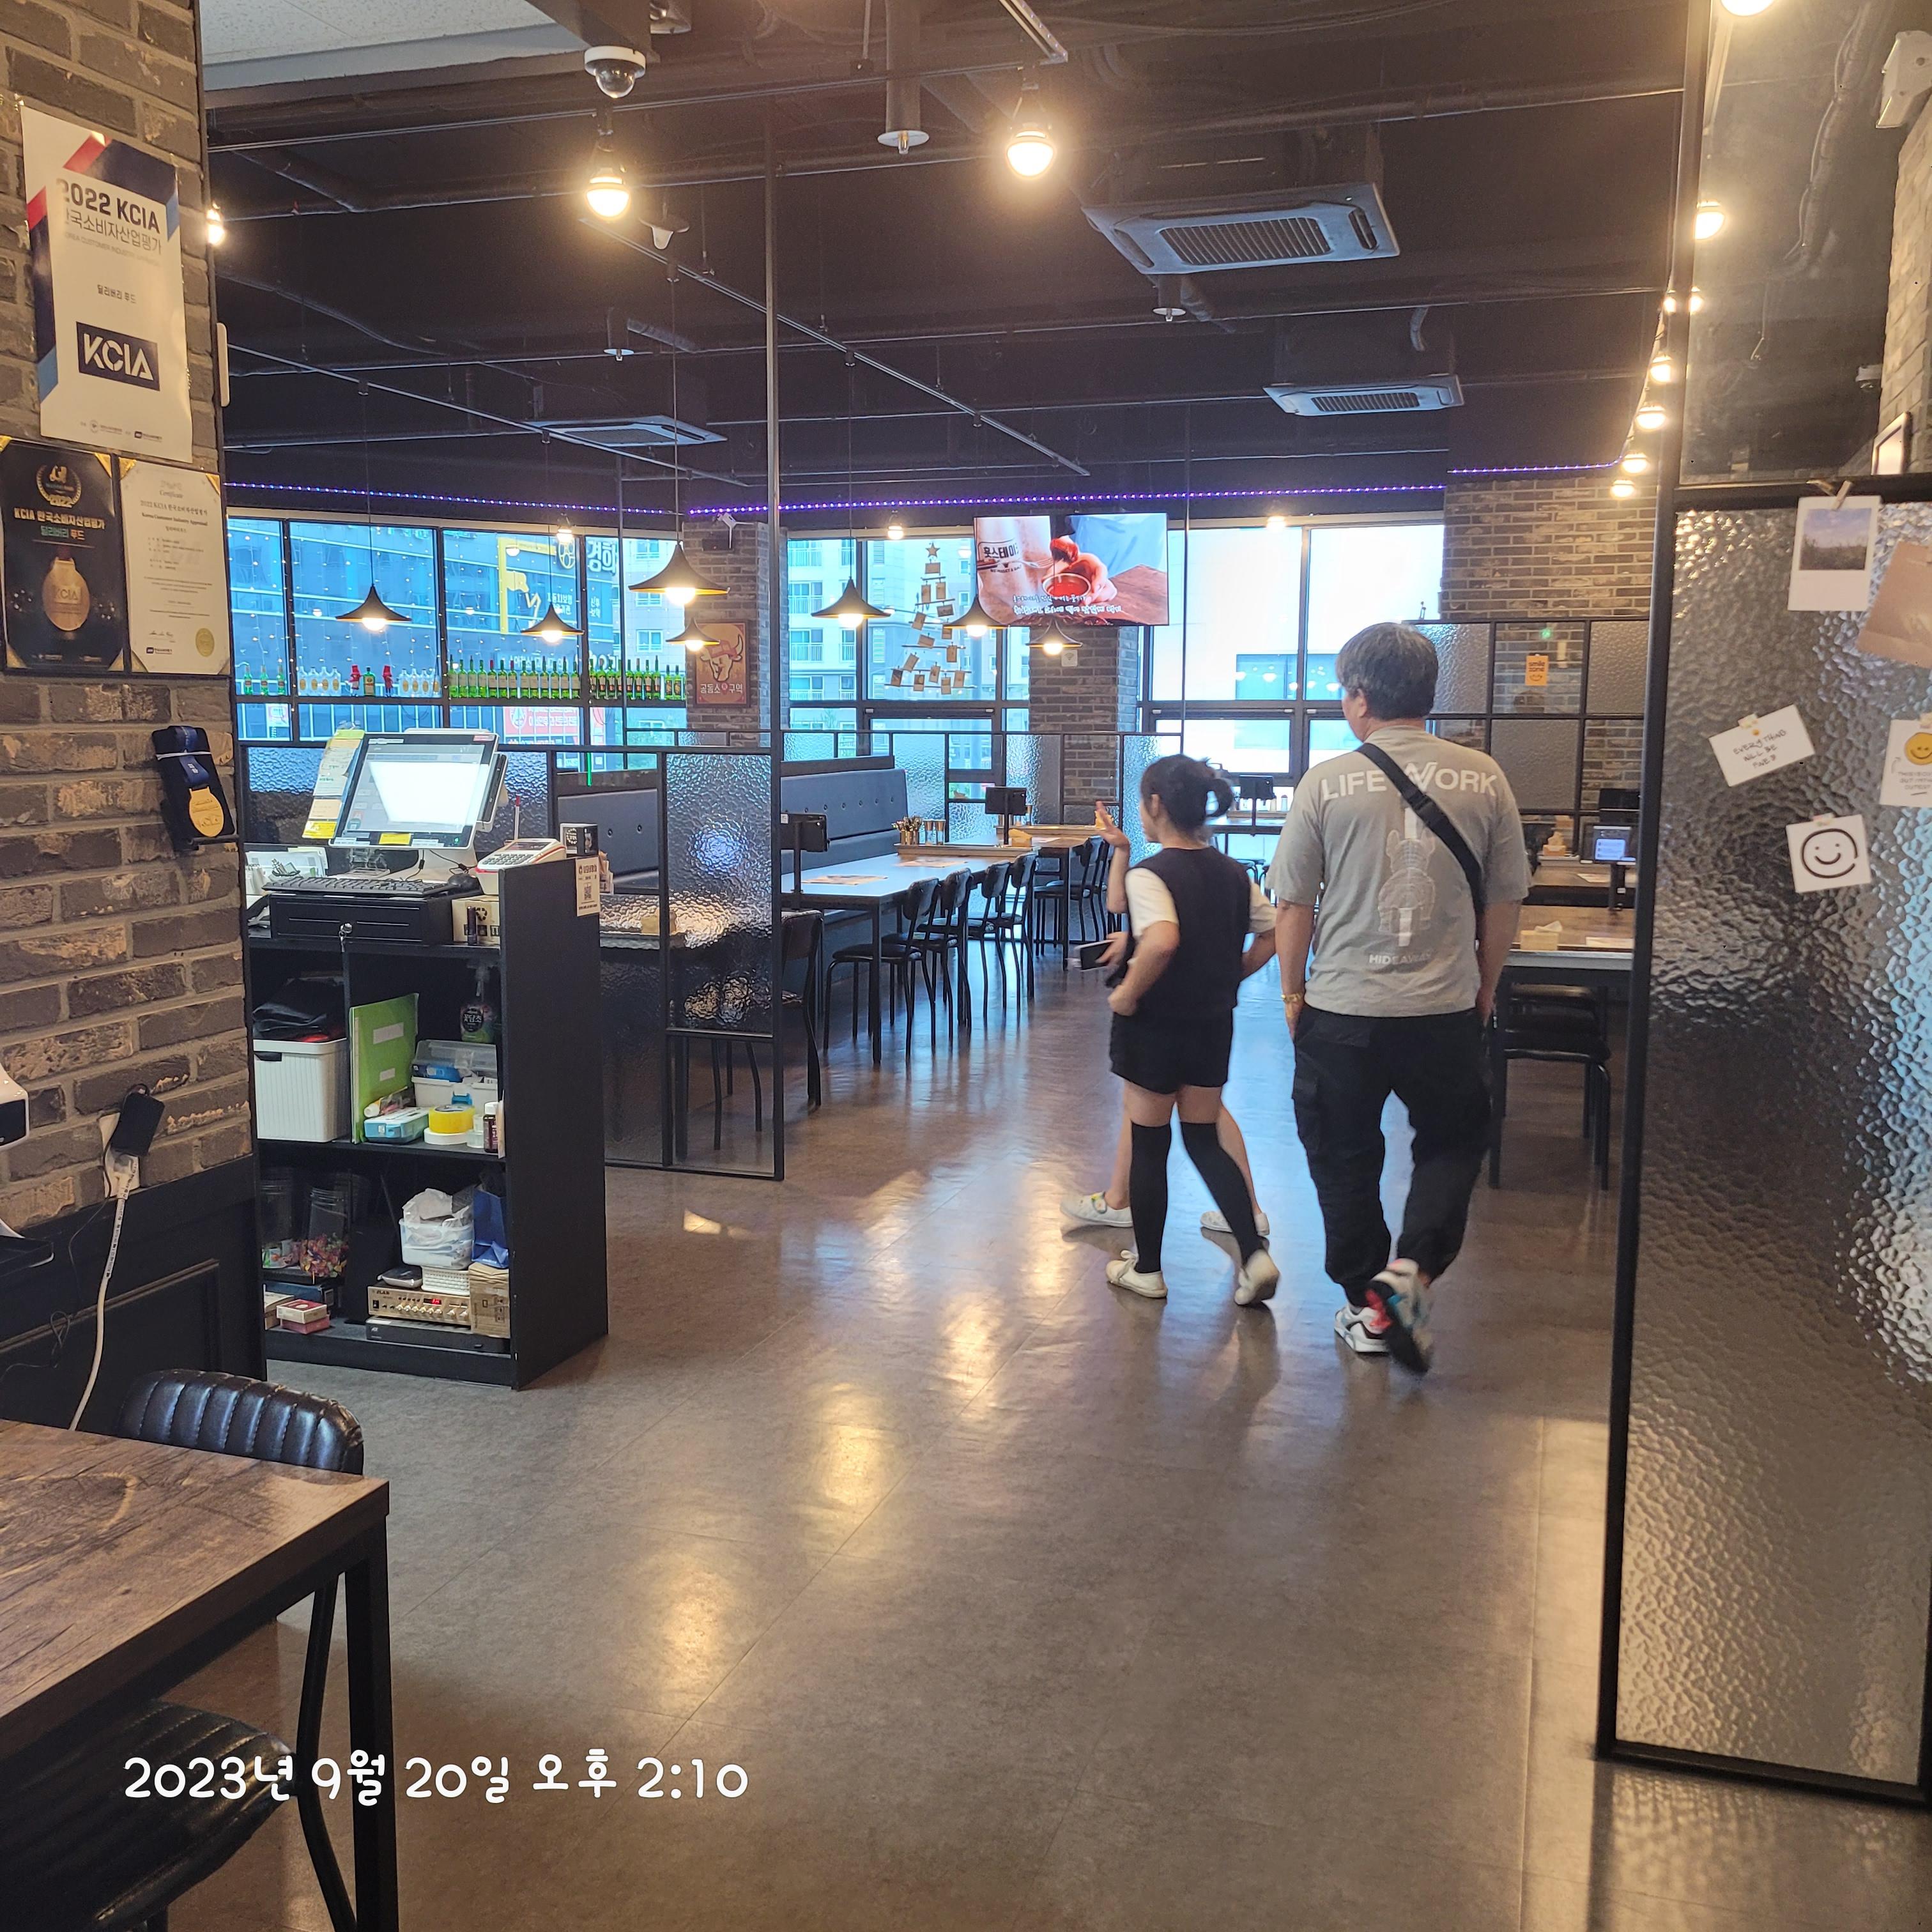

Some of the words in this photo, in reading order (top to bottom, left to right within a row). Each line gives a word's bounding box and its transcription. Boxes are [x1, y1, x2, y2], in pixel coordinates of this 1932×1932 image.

[117, 197, 160, 234] KCIA
[84, 334, 153, 381] KCIA
[14, 507, 35, 520] KCIA
[1321, 769, 1387, 801] LIFE
[1405, 762, 1498, 796] WORK
